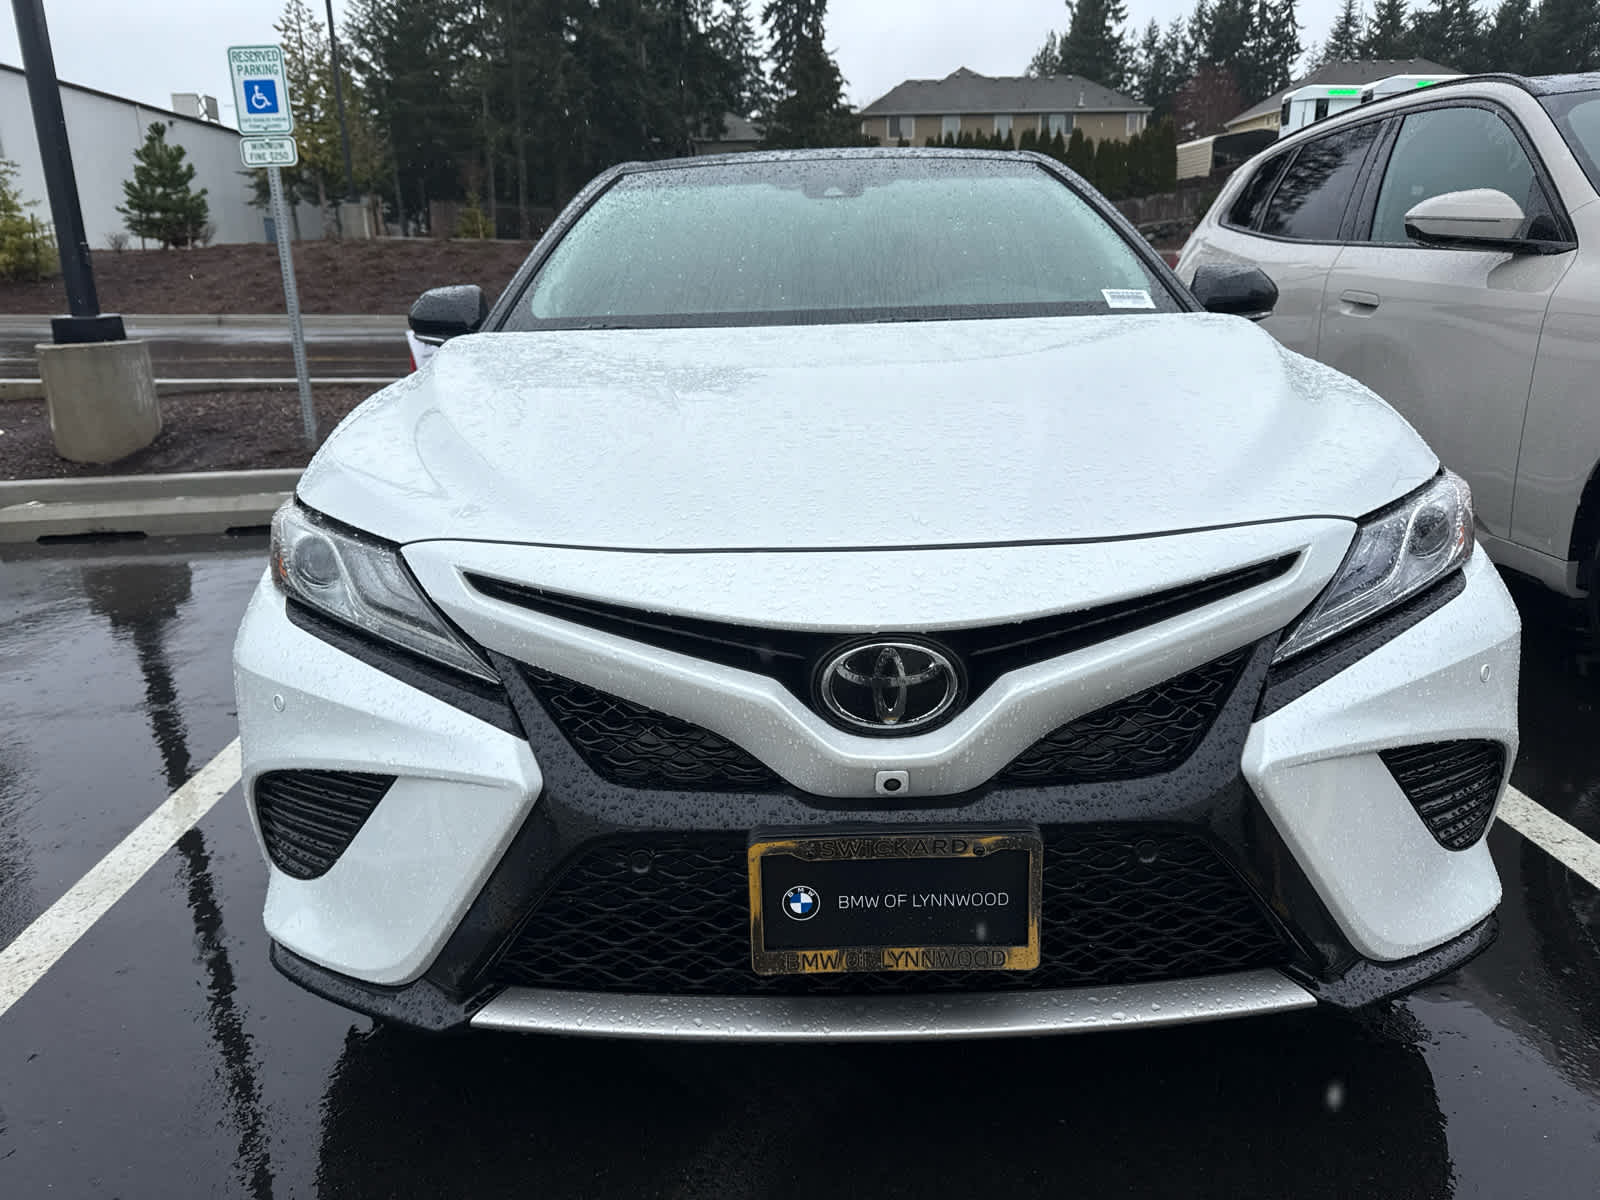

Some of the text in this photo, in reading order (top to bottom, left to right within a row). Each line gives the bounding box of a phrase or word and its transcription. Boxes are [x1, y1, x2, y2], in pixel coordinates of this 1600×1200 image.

[231, 50, 279, 62] RESERVED
[236, 64, 279, 76] PARKING
[822, 838, 968, 857] SWICKARD
[838, 892, 1009, 909] BMW OF LYNNWOOD
[784, 950, 841, 971] BMW
[880, 950, 1007, 969] LYNNWOOD
